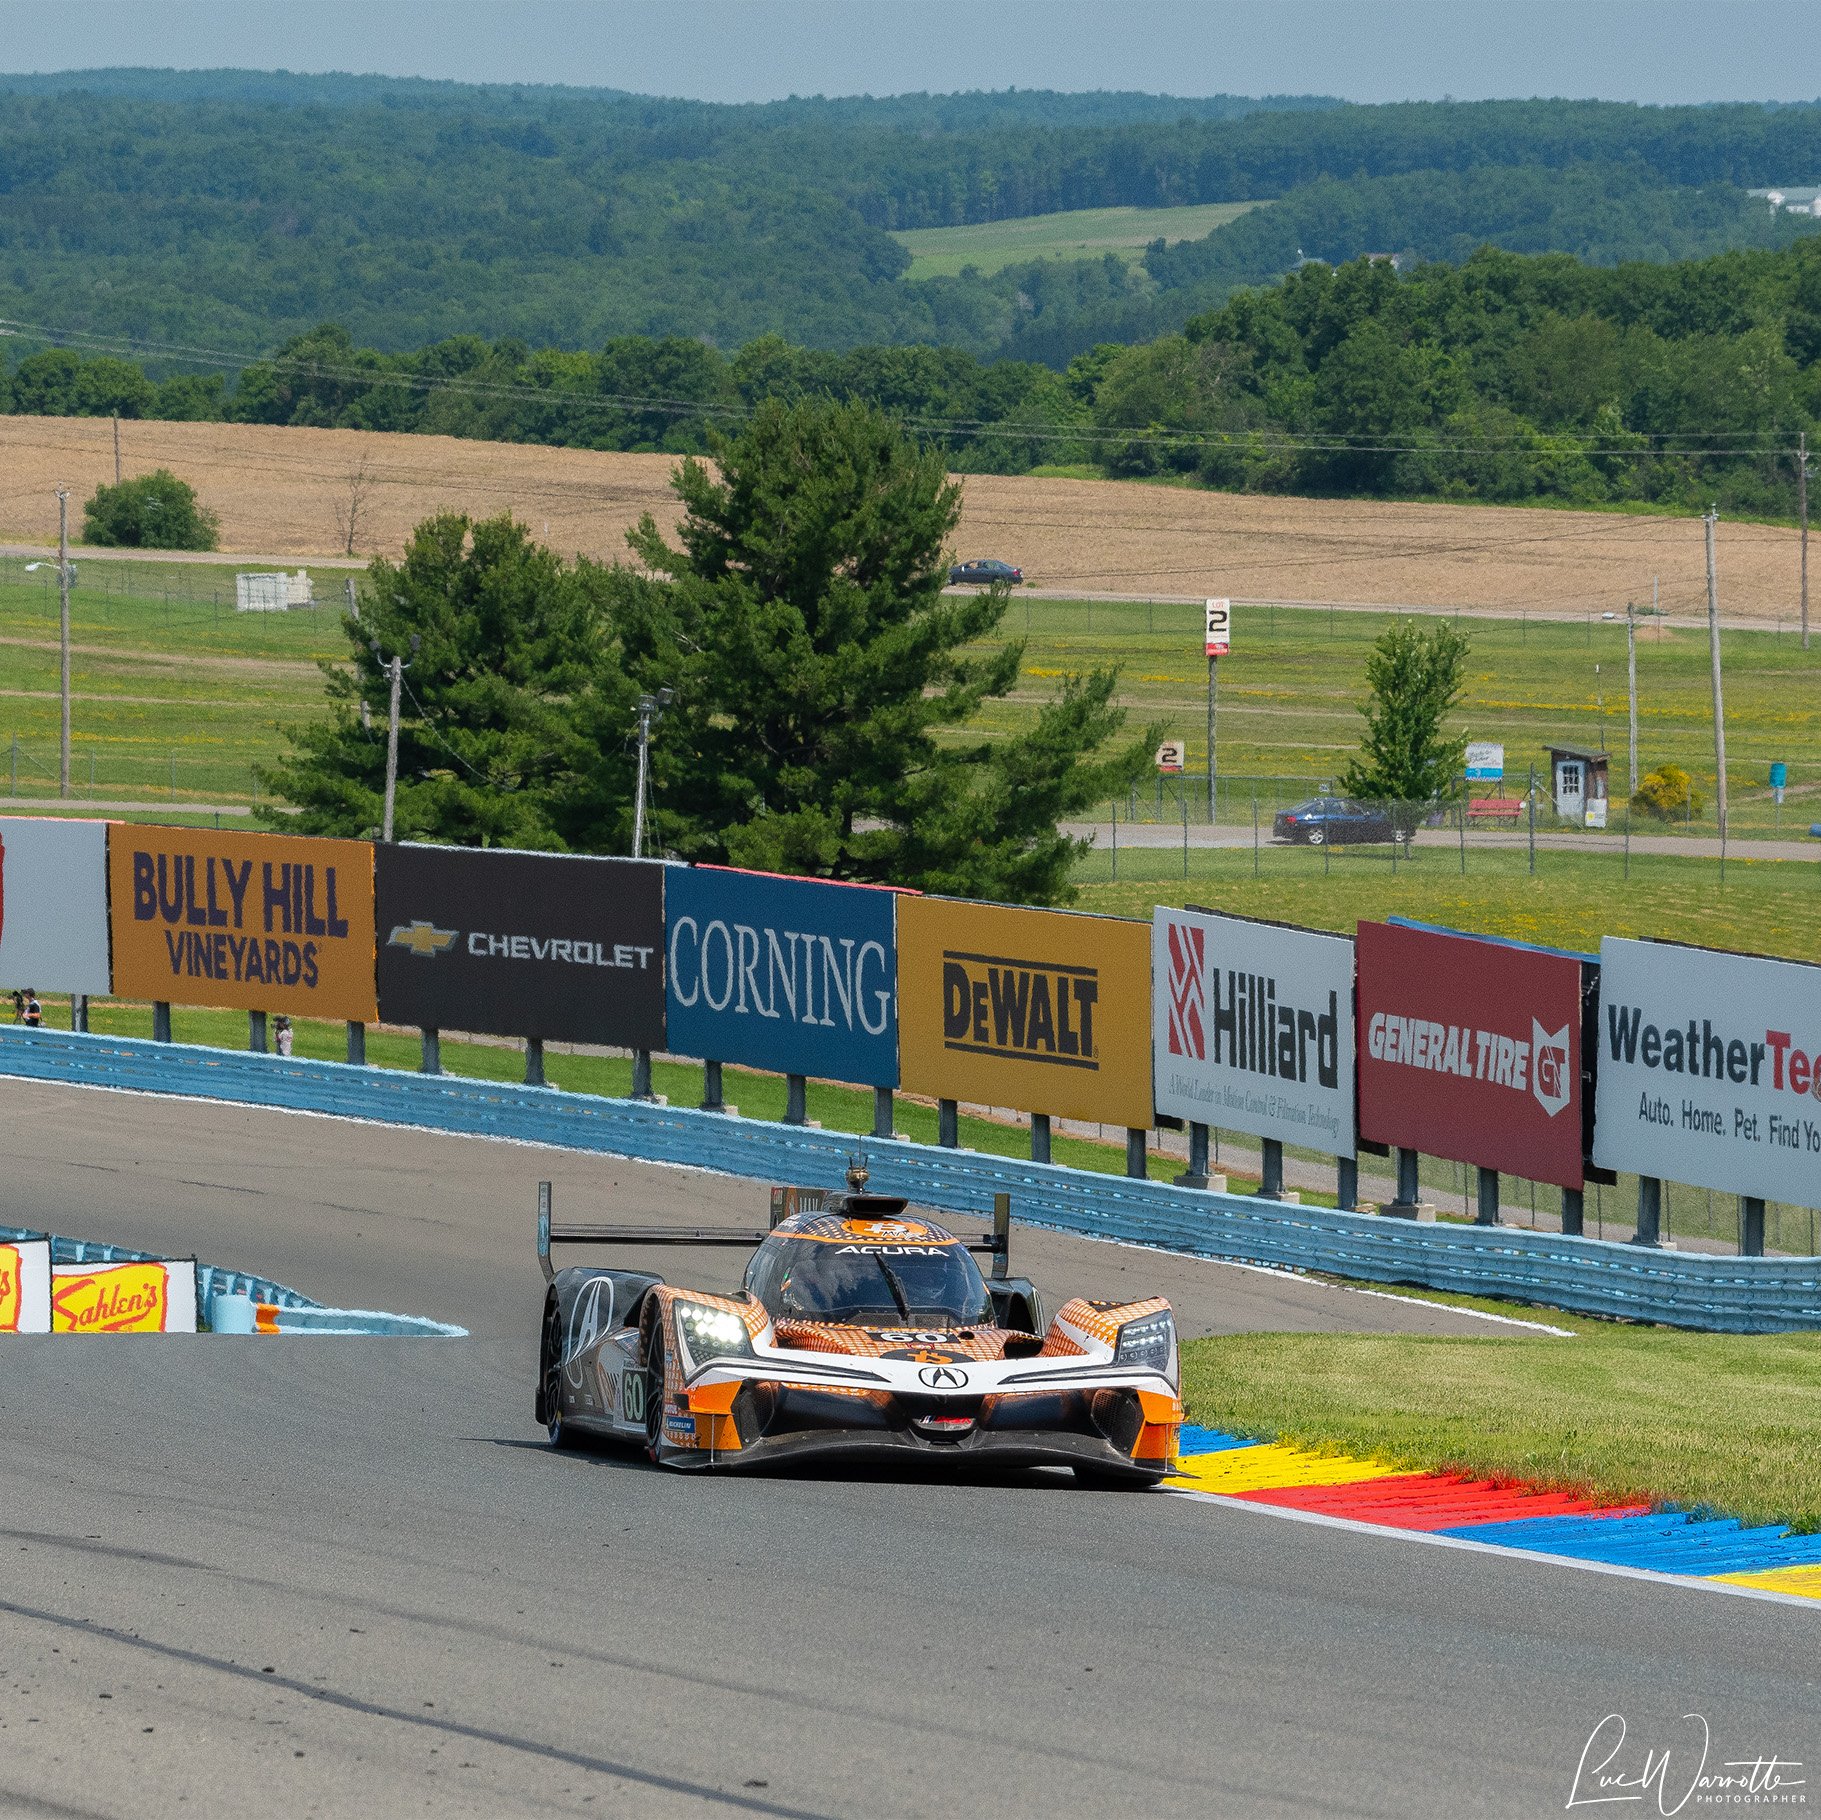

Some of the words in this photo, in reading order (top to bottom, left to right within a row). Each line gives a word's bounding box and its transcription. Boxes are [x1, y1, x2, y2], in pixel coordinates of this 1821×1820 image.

[1208, 610, 1228, 632] 2
[1161, 747, 1178, 763] 2
[133, 851, 253, 929] BULLY
[263, 861, 349, 939] HILL
[164, 929, 321, 989] VINEYARDS
[467, 932, 654, 970] CHEVROLET
[670, 916, 891, 1036] CORNING
[1213, 967, 1338, 1090] Hilliard
[1369, 1012, 1472, 1079] GENERAL
[1474, 1031, 1530, 1091] TIRE
[1638, 1091, 1674, 1127] Auto.
[1682, 1099, 1727, 1137] Home.
[1734, 1107, 1761, 1143] Pet.
[1768, 1114, 1800, 1150] Find
[835, 1245, 950, 1257] ACURA
[53, 1278, 158, 1331] Sahlen's
[880, 1332, 948, 1343] 60
[624, 1372, 644, 1421] 60
